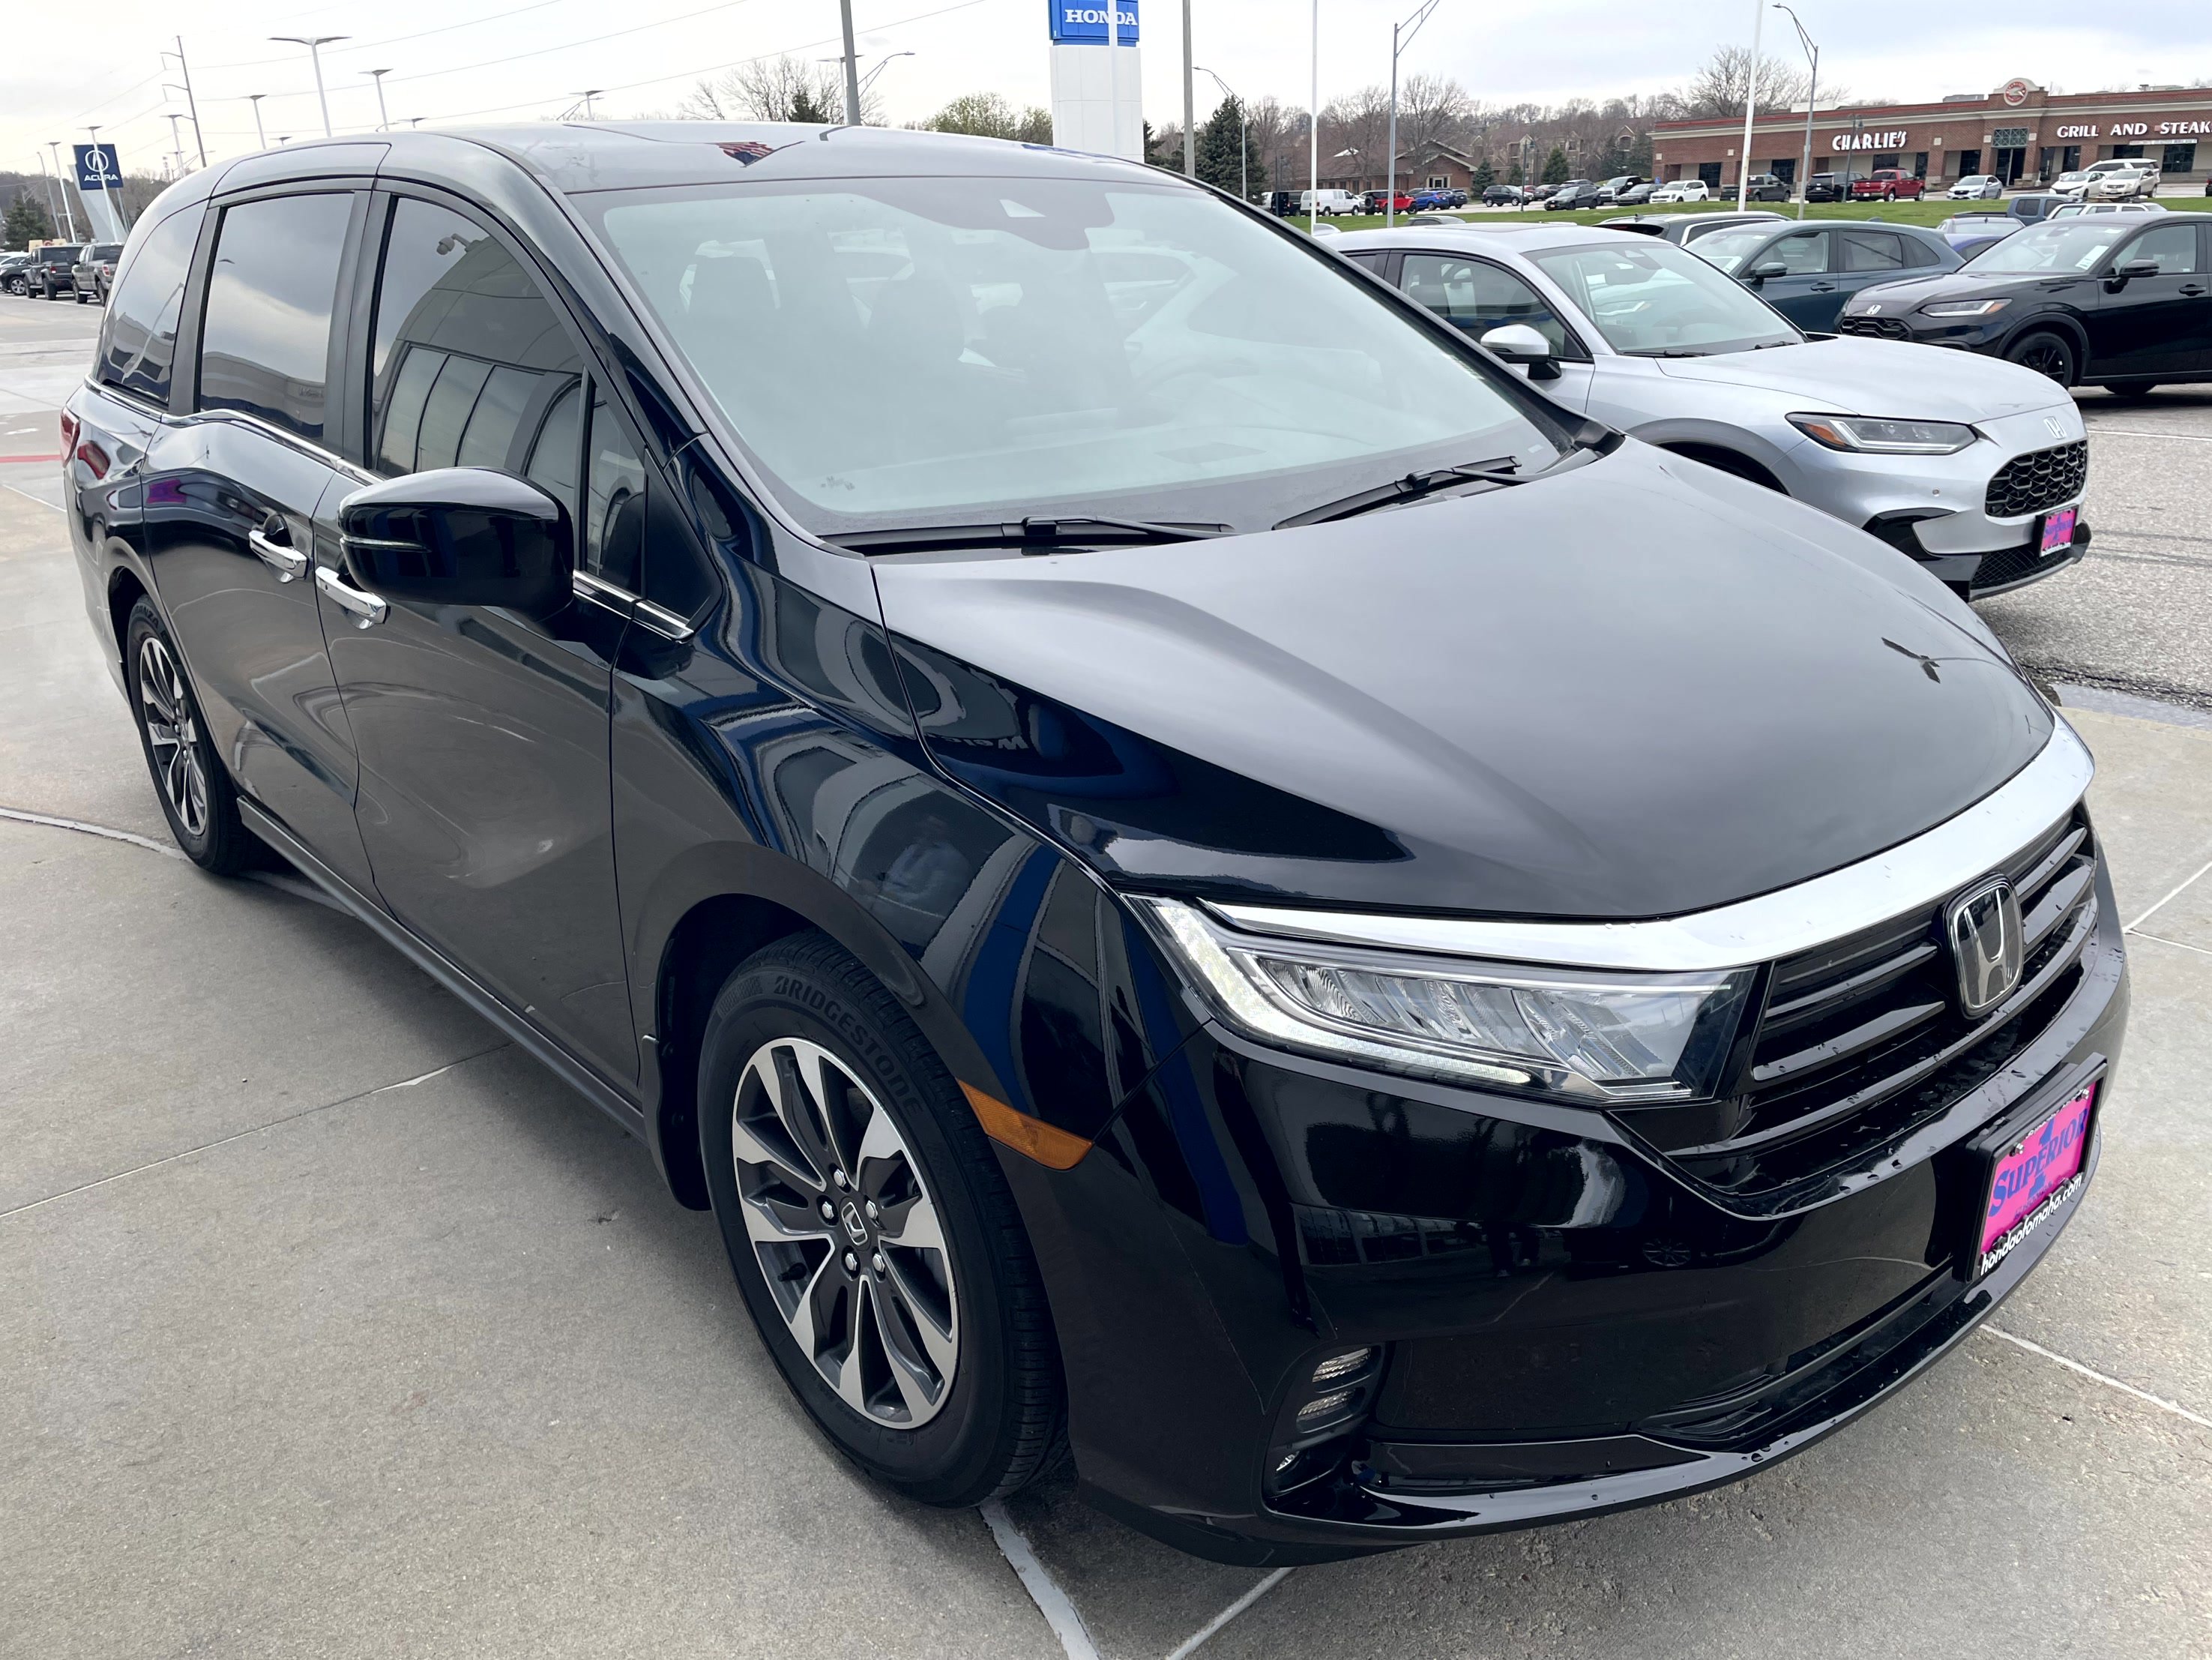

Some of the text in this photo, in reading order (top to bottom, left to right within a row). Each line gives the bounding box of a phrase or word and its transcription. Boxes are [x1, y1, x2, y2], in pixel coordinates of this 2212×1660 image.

[1064, 9, 1138, 25] HONDA
[1832, 130, 1907, 151] CHARLIE'S
[2057, 121, 2212, 138] GRILL AND STEAK
[774, 975, 925, 1116] BRIDGESTONE
[1989, 1108, 2088, 1217] SUPERIOR
[1980, 1175, 2082, 1276] hondaofomaha.com
